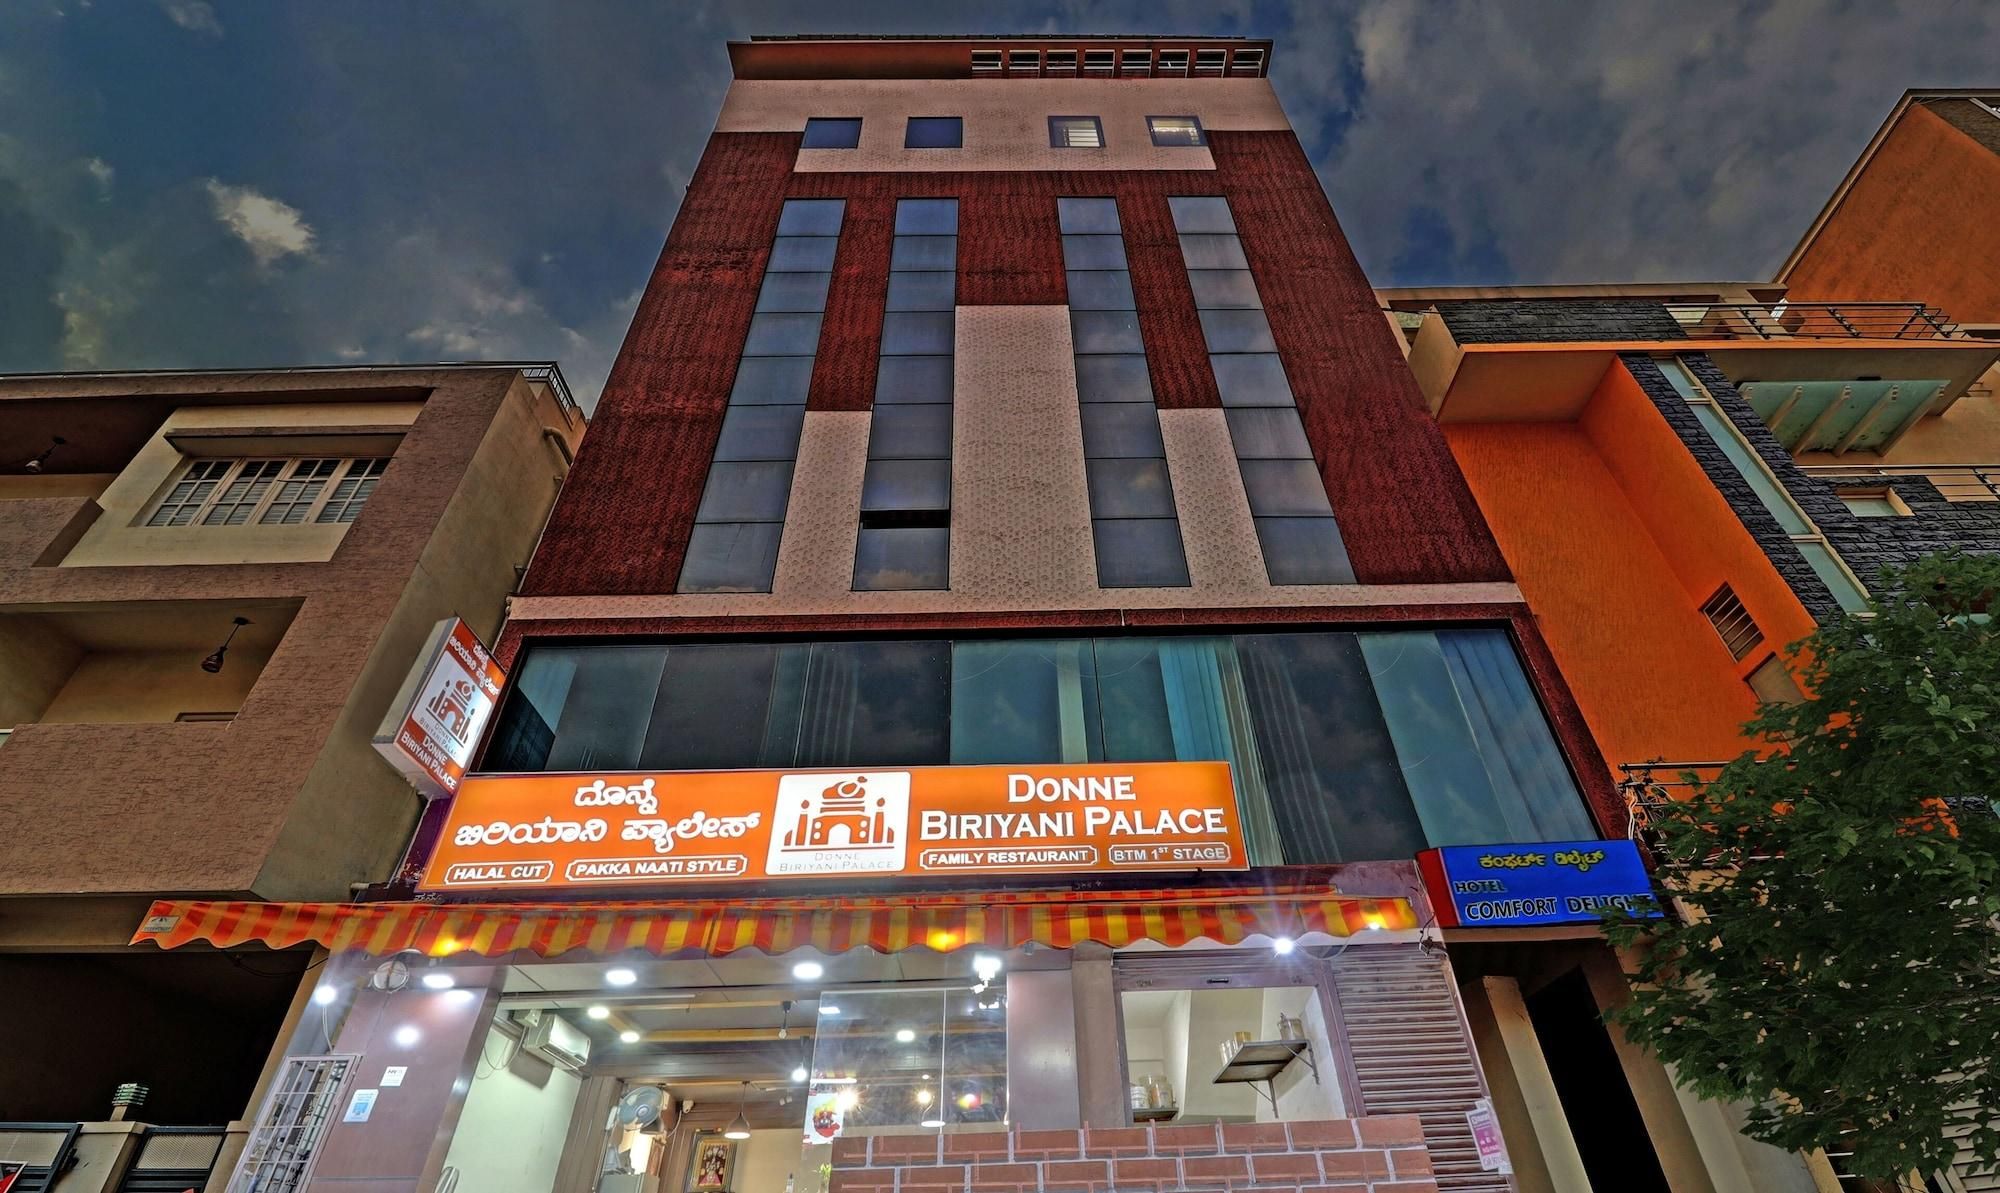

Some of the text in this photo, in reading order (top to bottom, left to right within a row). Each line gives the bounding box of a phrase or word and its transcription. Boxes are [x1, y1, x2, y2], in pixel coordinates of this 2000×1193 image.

[401, 731, 457, 790] BIRIYANI PALACE
[422, 735, 448, 765] DONNE
[575, 778, 659, 815] ದೊನ್ನೆ
[1007, 774, 1136, 803] DONNE
[454, 811, 761, 853] ಬಿರಿಯಾನಿ ಪ್ಯಾಲೇಸ್
[920, 806, 1228, 841] BIRIYANI PALACE
[780, 860, 894, 872] BIRIYANI PALACE
[928, 850, 1089, 865] FAMILY RESTAURANT
[1114, 849, 1147, 862] BTM
[1173, 847, 1226, 861] STAGE
[453, 865, 544, 880] HALAL CUT
[575, 859, 737, 876] PAKKA NAATI STYLE
[1455, 880, 1507, 895] HOTEL
[1466, 897, 1558, 921] COMFORT
